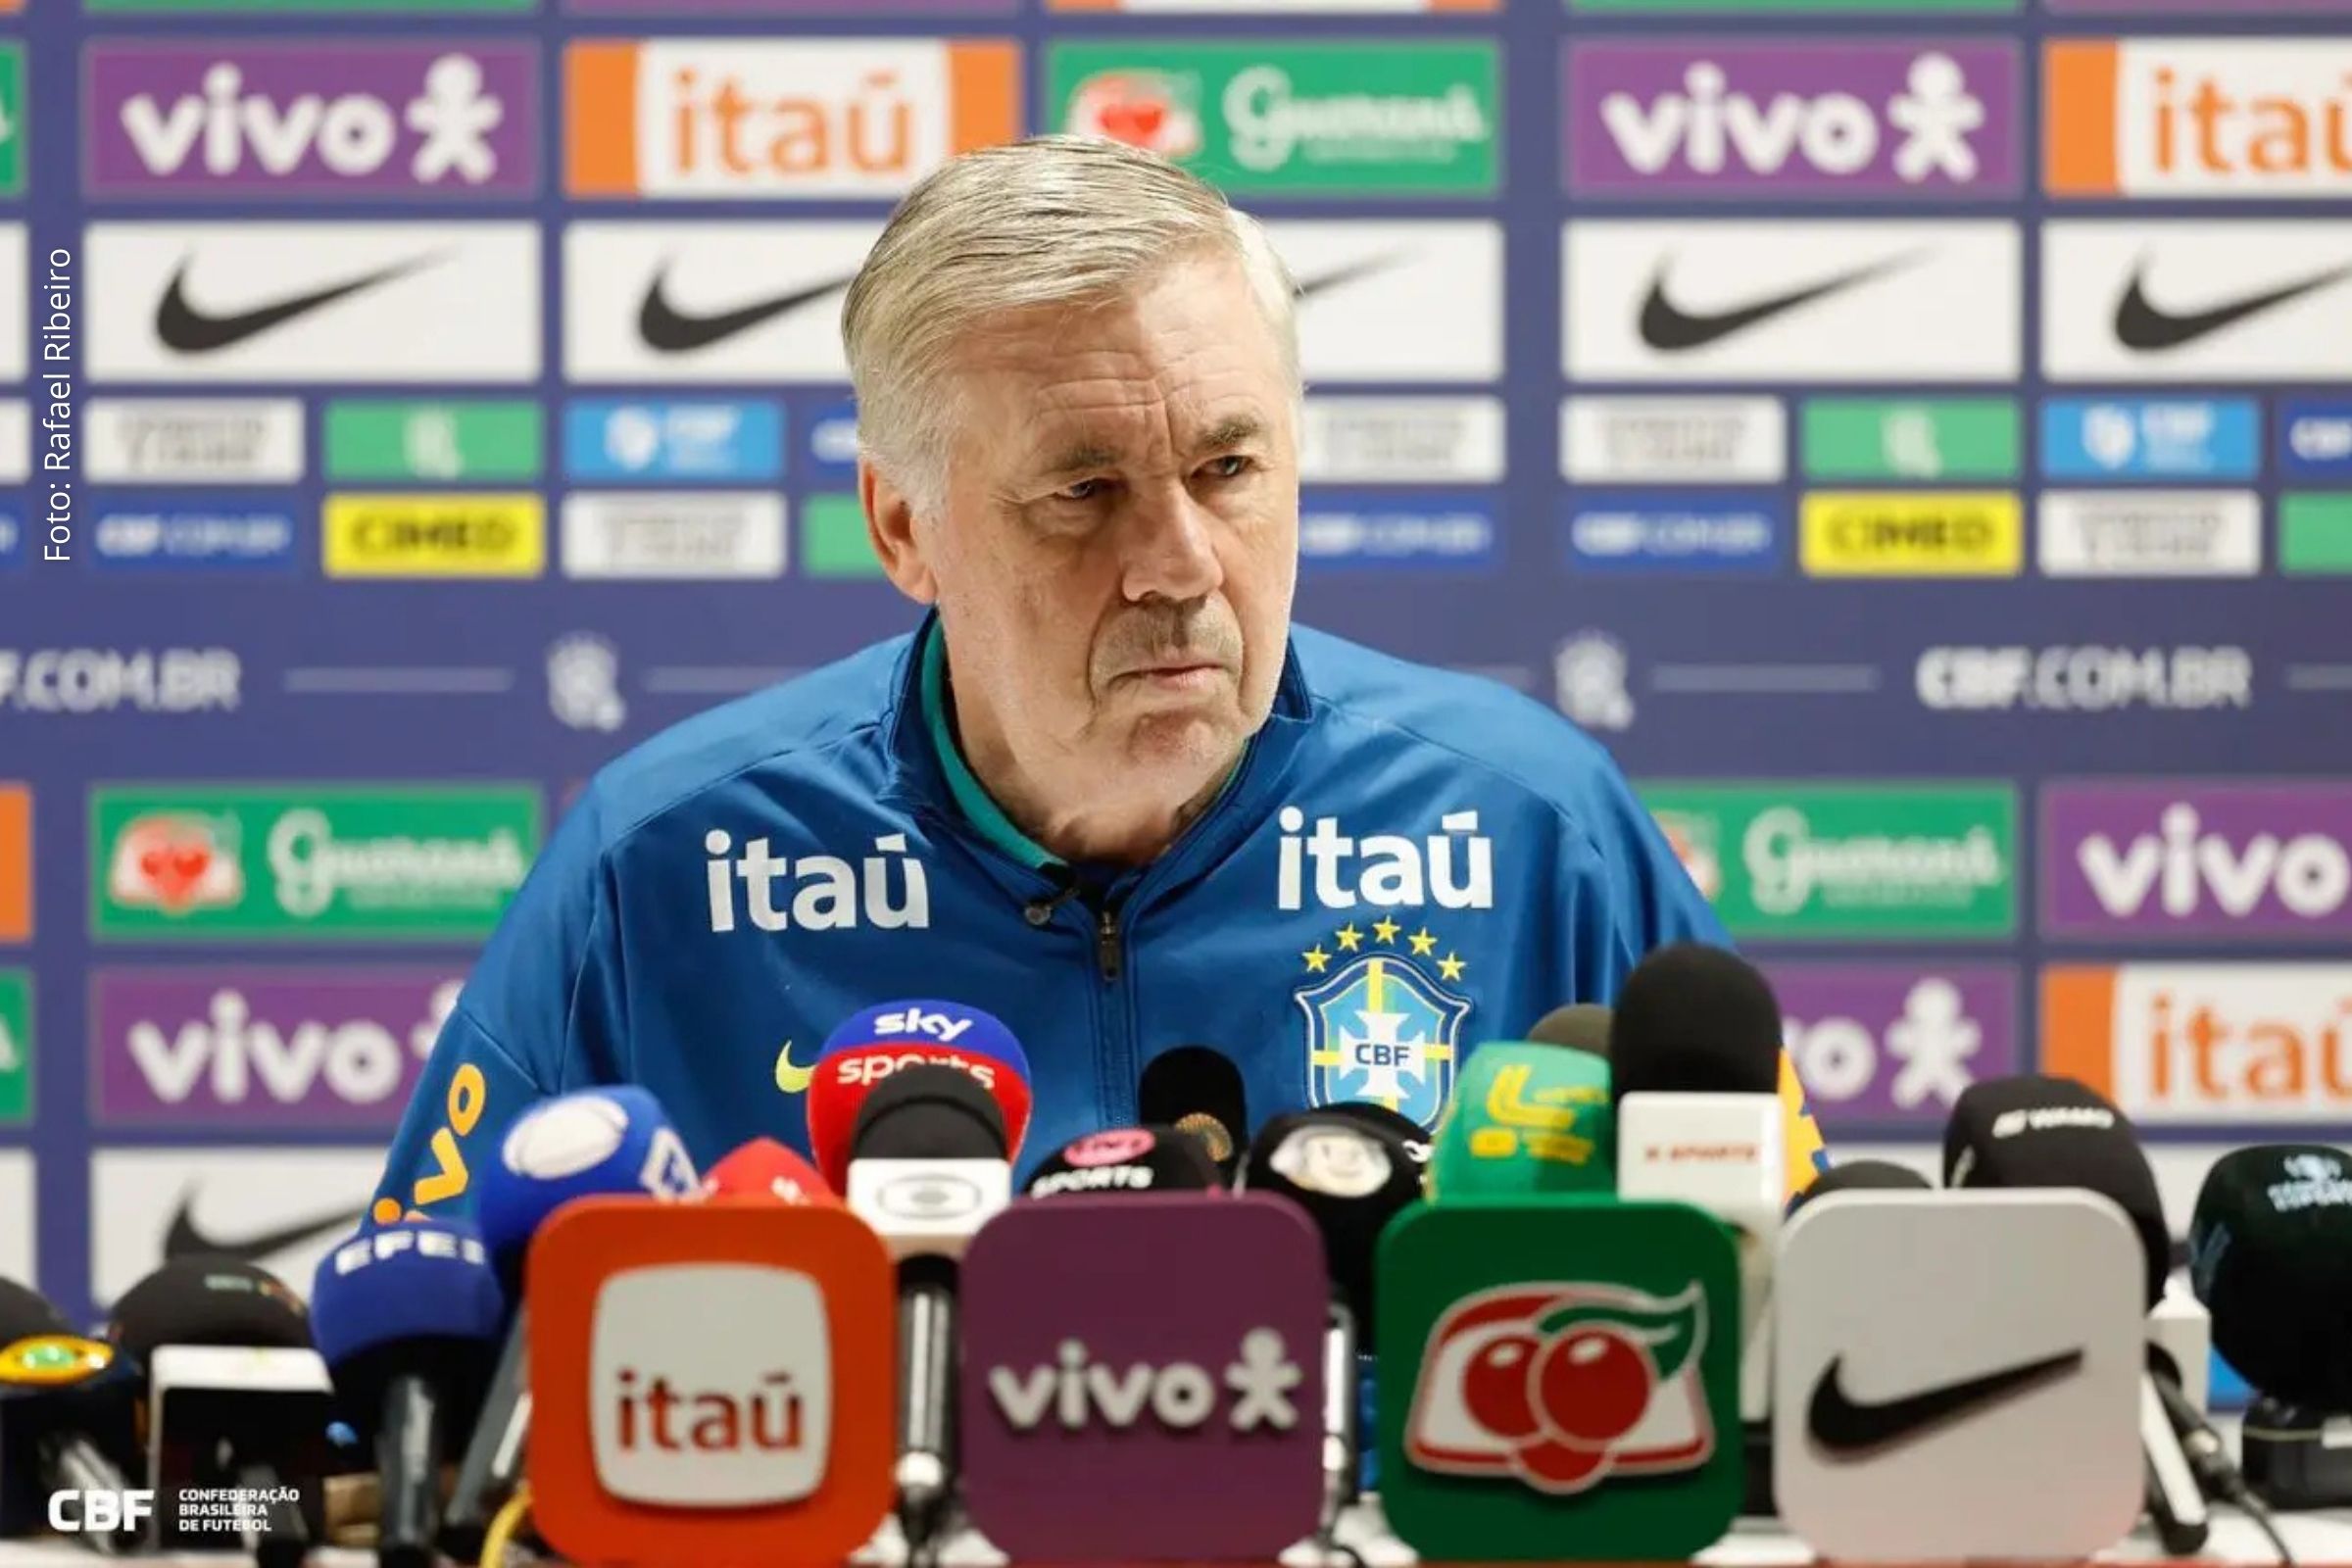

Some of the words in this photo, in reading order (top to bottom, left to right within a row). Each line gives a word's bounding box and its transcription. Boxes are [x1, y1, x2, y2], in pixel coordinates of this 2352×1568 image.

[121, 62, 395, 174] vivo
[675, 67, 909, 174] itaú
[1599, 61, 1879, 174] vivo
[706, 829, 929, 932] itaú
[1279, 806, 1493, 910] itaú
[2076, 801, 2351, 918] vivo
[128, 988, 401, 1103] vivo
[874, 1007, 972, 1041] sky
[1354, 1043, 1411, 1066] CBF
[617, 1368, 802, 1451] itaú
[989, 1338, 1215, 1428] vivo
